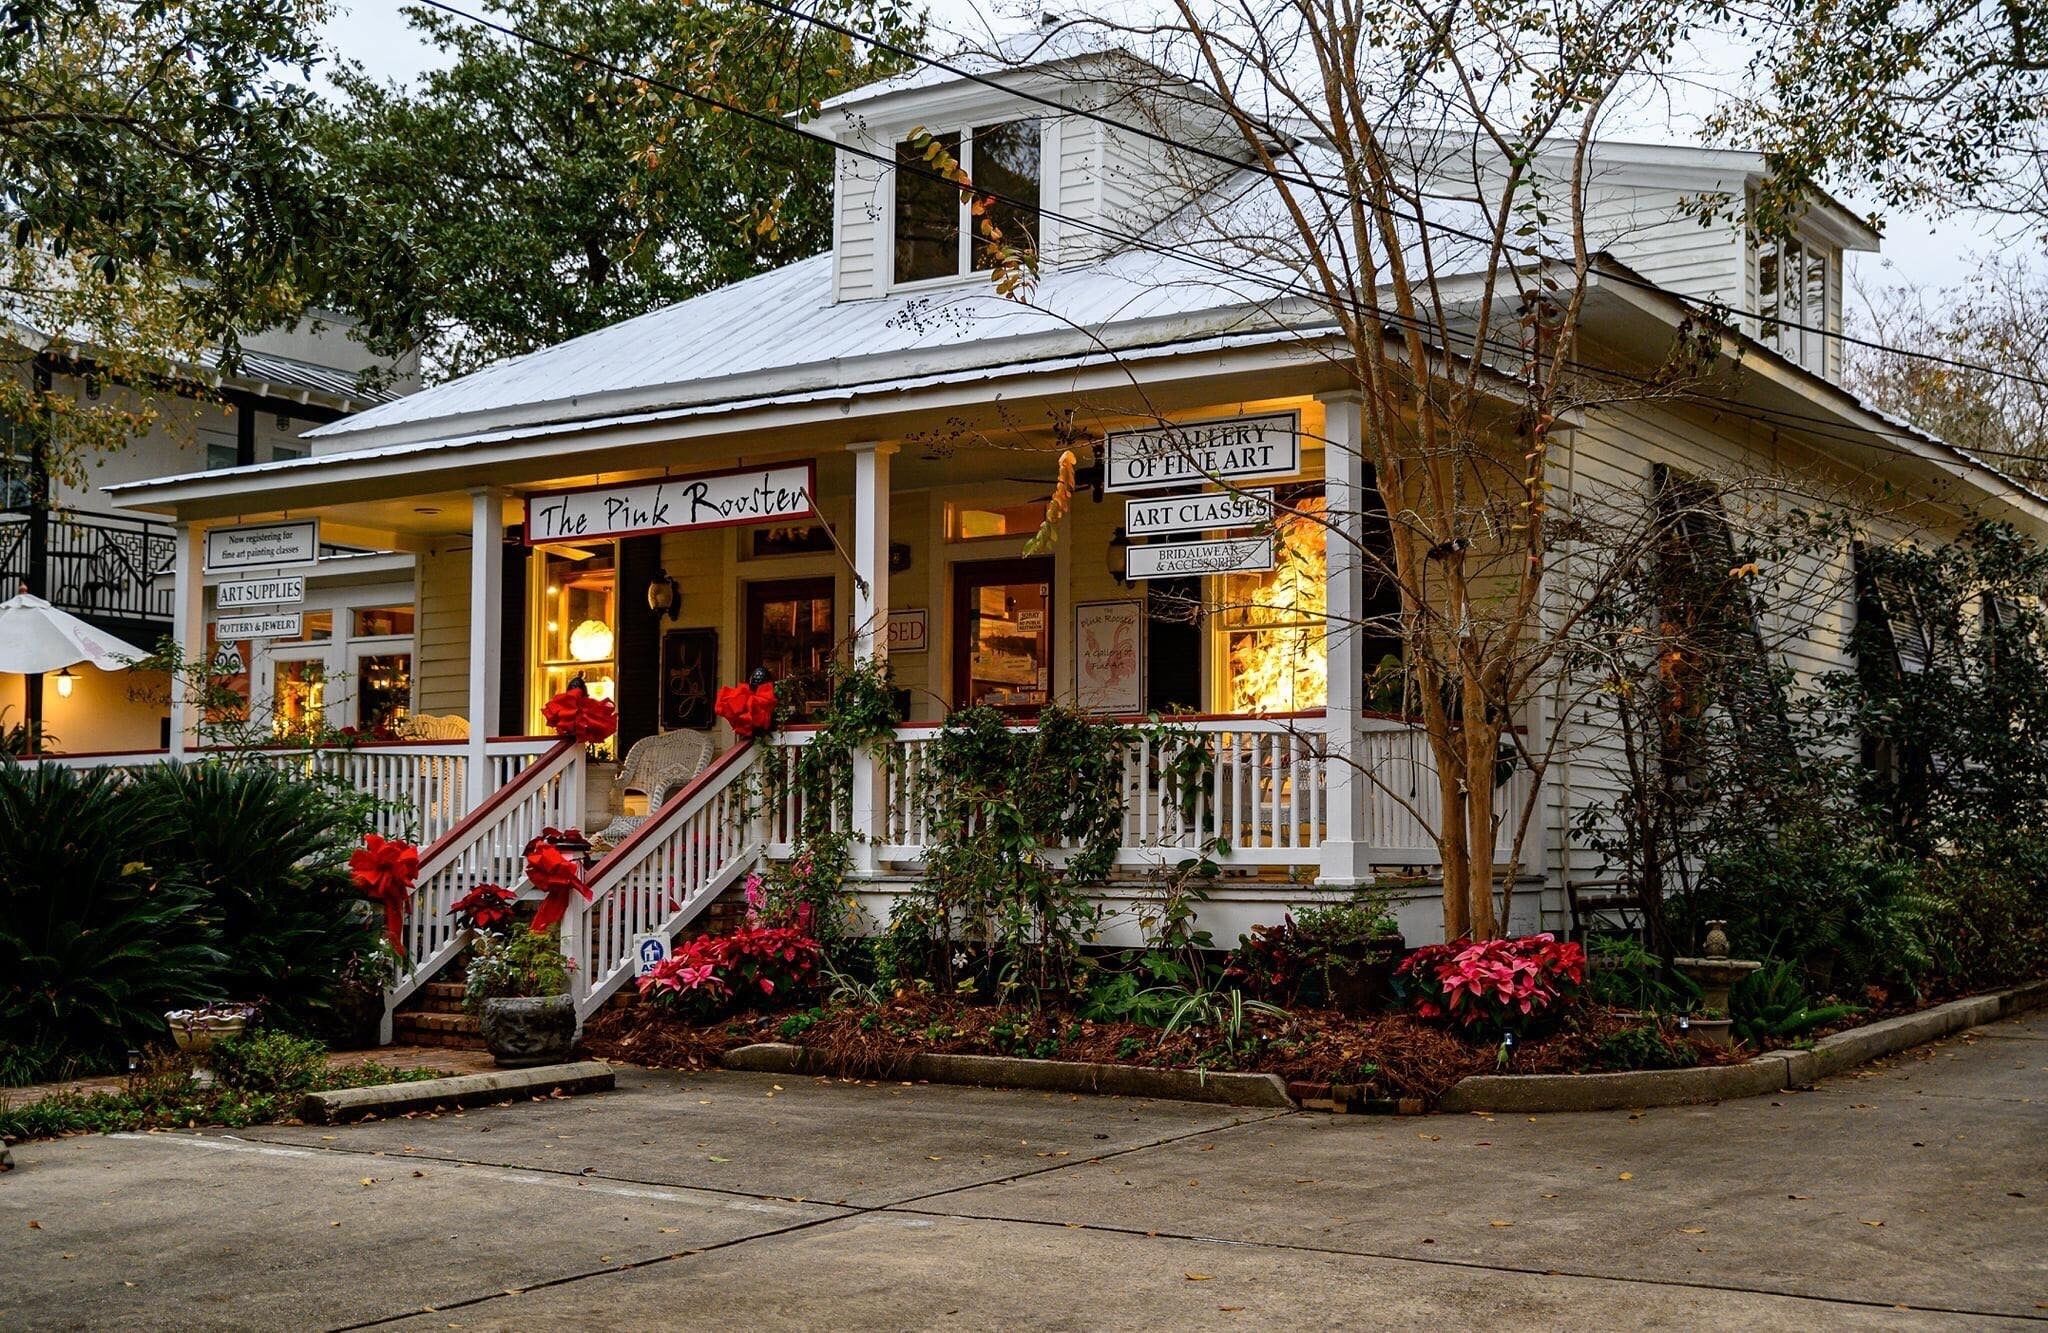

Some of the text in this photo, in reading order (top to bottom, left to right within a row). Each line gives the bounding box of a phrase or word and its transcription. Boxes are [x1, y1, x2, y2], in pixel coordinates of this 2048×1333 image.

[1136, 425, 1267, 456] A GALLERY
[1128, 446, 1274, 478] OF FINE ART
[539, 472, 804, 536] The Pink Rooster
[1133, 500, 1267, 526] ART CLASSES
[228, 530, 293, 545] Now registering for
[222, 545, 299, 560] fine art painting classes
[1159, 545, 1239, 560] BRIDALWEAR
[1156, 561, 1165, 572] &
[221, 581, 300, 602] ART SUPPLIES
[220, 620, 296, 633] POTTERY & JEWELRY
[888, 621, 924, 642] SED
[641, 964, 656, 972] AS
